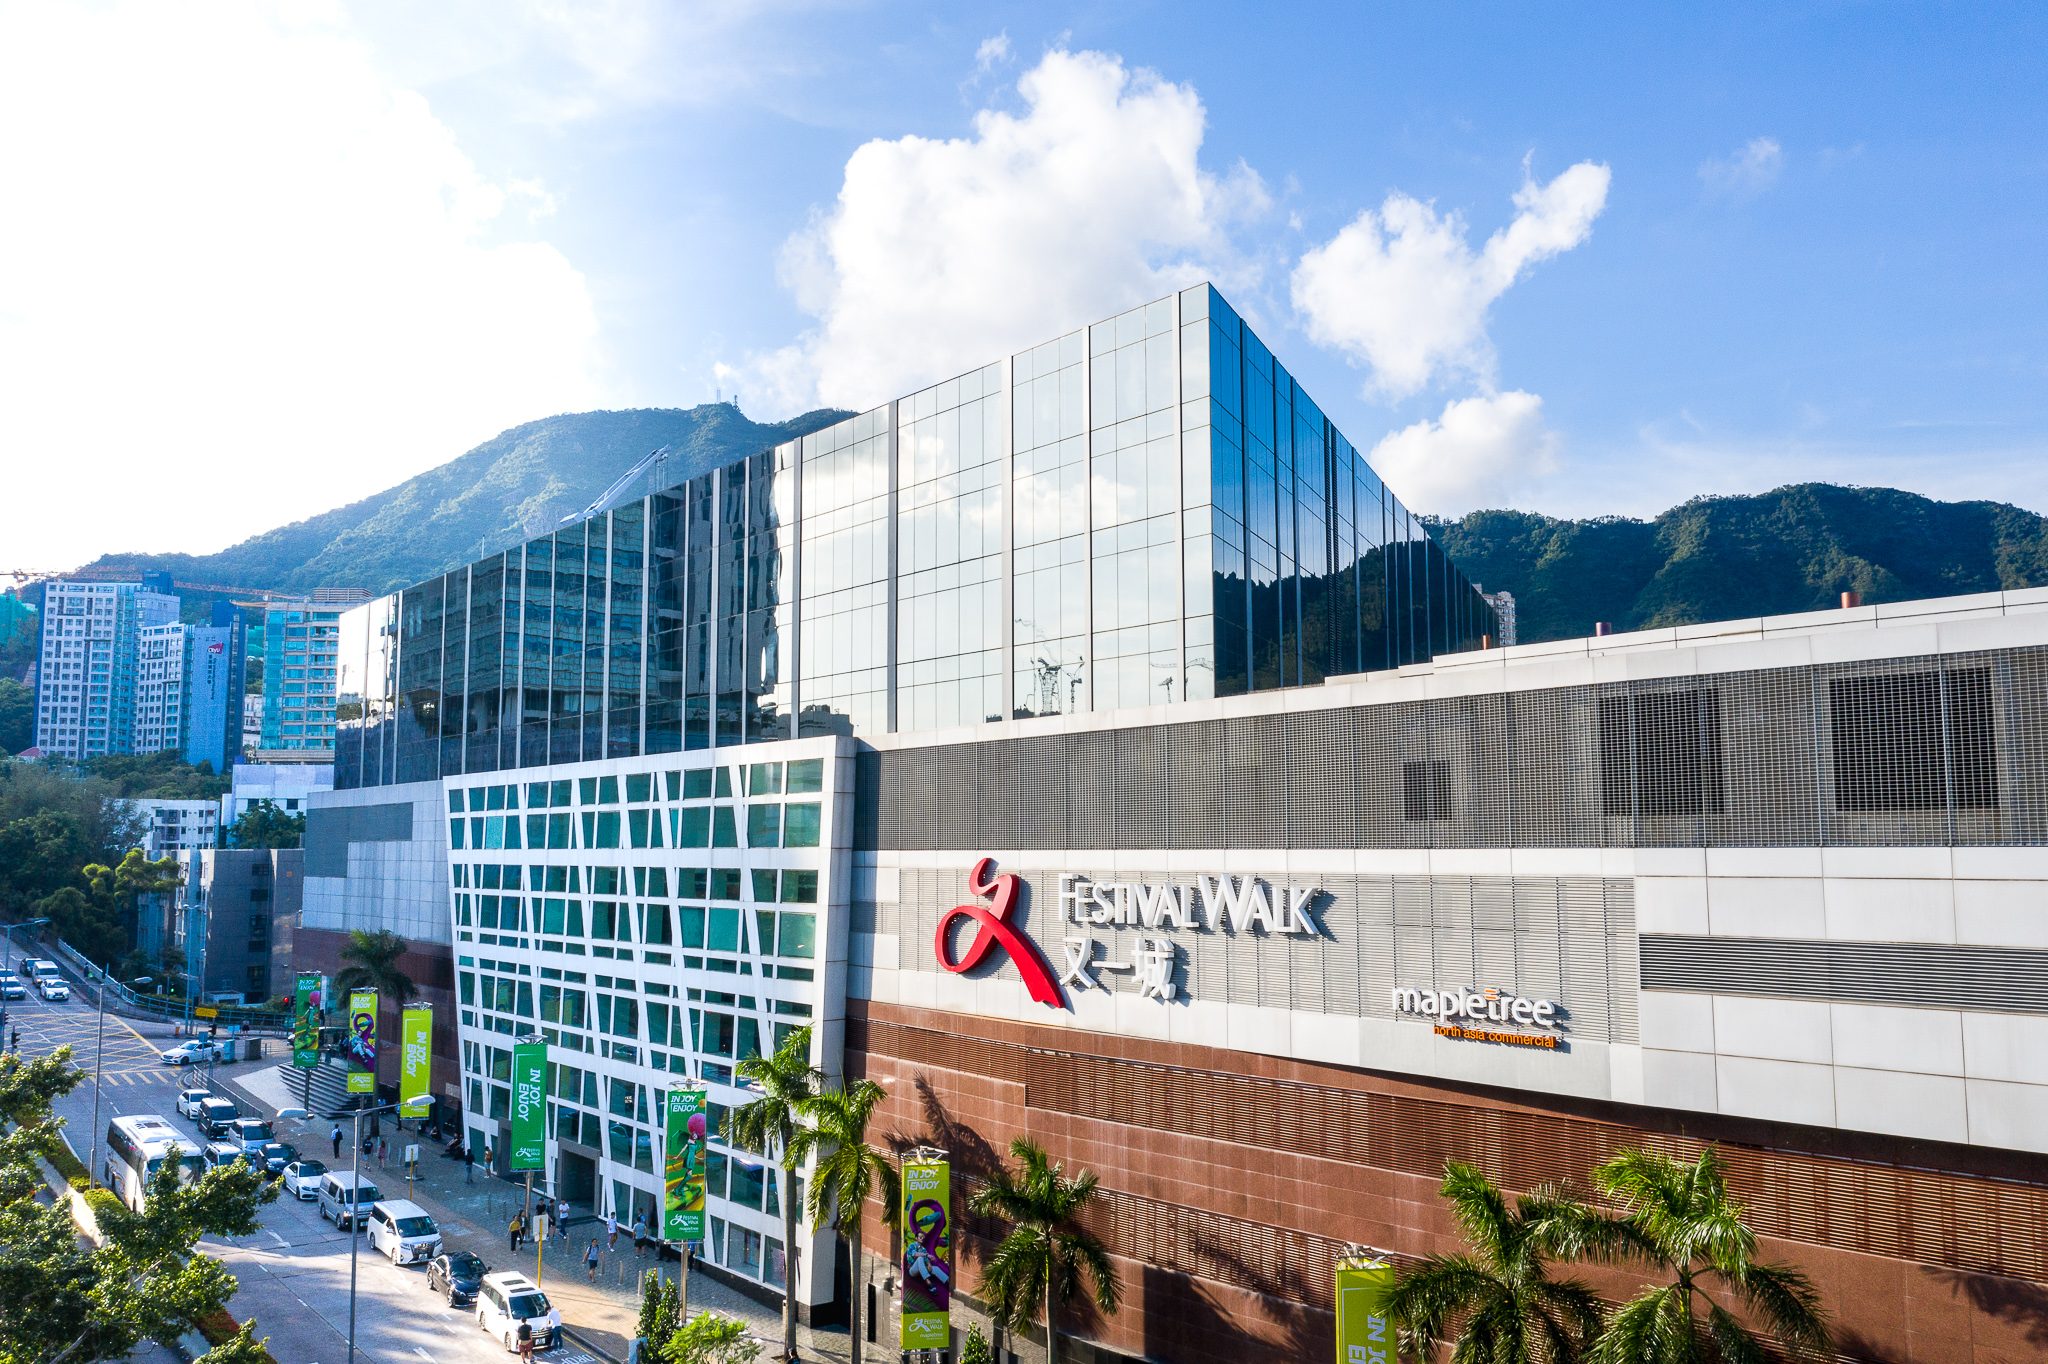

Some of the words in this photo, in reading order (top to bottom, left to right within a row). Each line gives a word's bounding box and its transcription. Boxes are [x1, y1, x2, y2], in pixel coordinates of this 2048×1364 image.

[1059, 873, 1199, 928] FESTIVAL
[1198, 872, 1320, 935] WALK
[1059, 937, 1176, 1000] 又一城
[1392, 987, 1555, 1026] mapletree
[417, 1031, 427, 1044] IN
[1434, 1026, 1461, 1037] north
[1463, 1030, 1485, 1041] asia
[1488, 1032, 1554, 1048] commercial
[406, 1044, 417, 1078] ENJOY
[417, 1045, 427, 1065] JOY
[530, 1068, 541, 1082] IN
[518, 1083, 530, 1122] ENJOY
[530, 1085, 541, 1108] JOY
[681, 1095, 697, 1103] JOY
[673, 1104, 698, 1112] ENJOY
[908, 1170, 919, 1179] IN
[920, 1169, 939, 1179] JOY
[910, 1181, 940, 1191] ENJOY
[1368, 1315, 1386, 1343] IN
